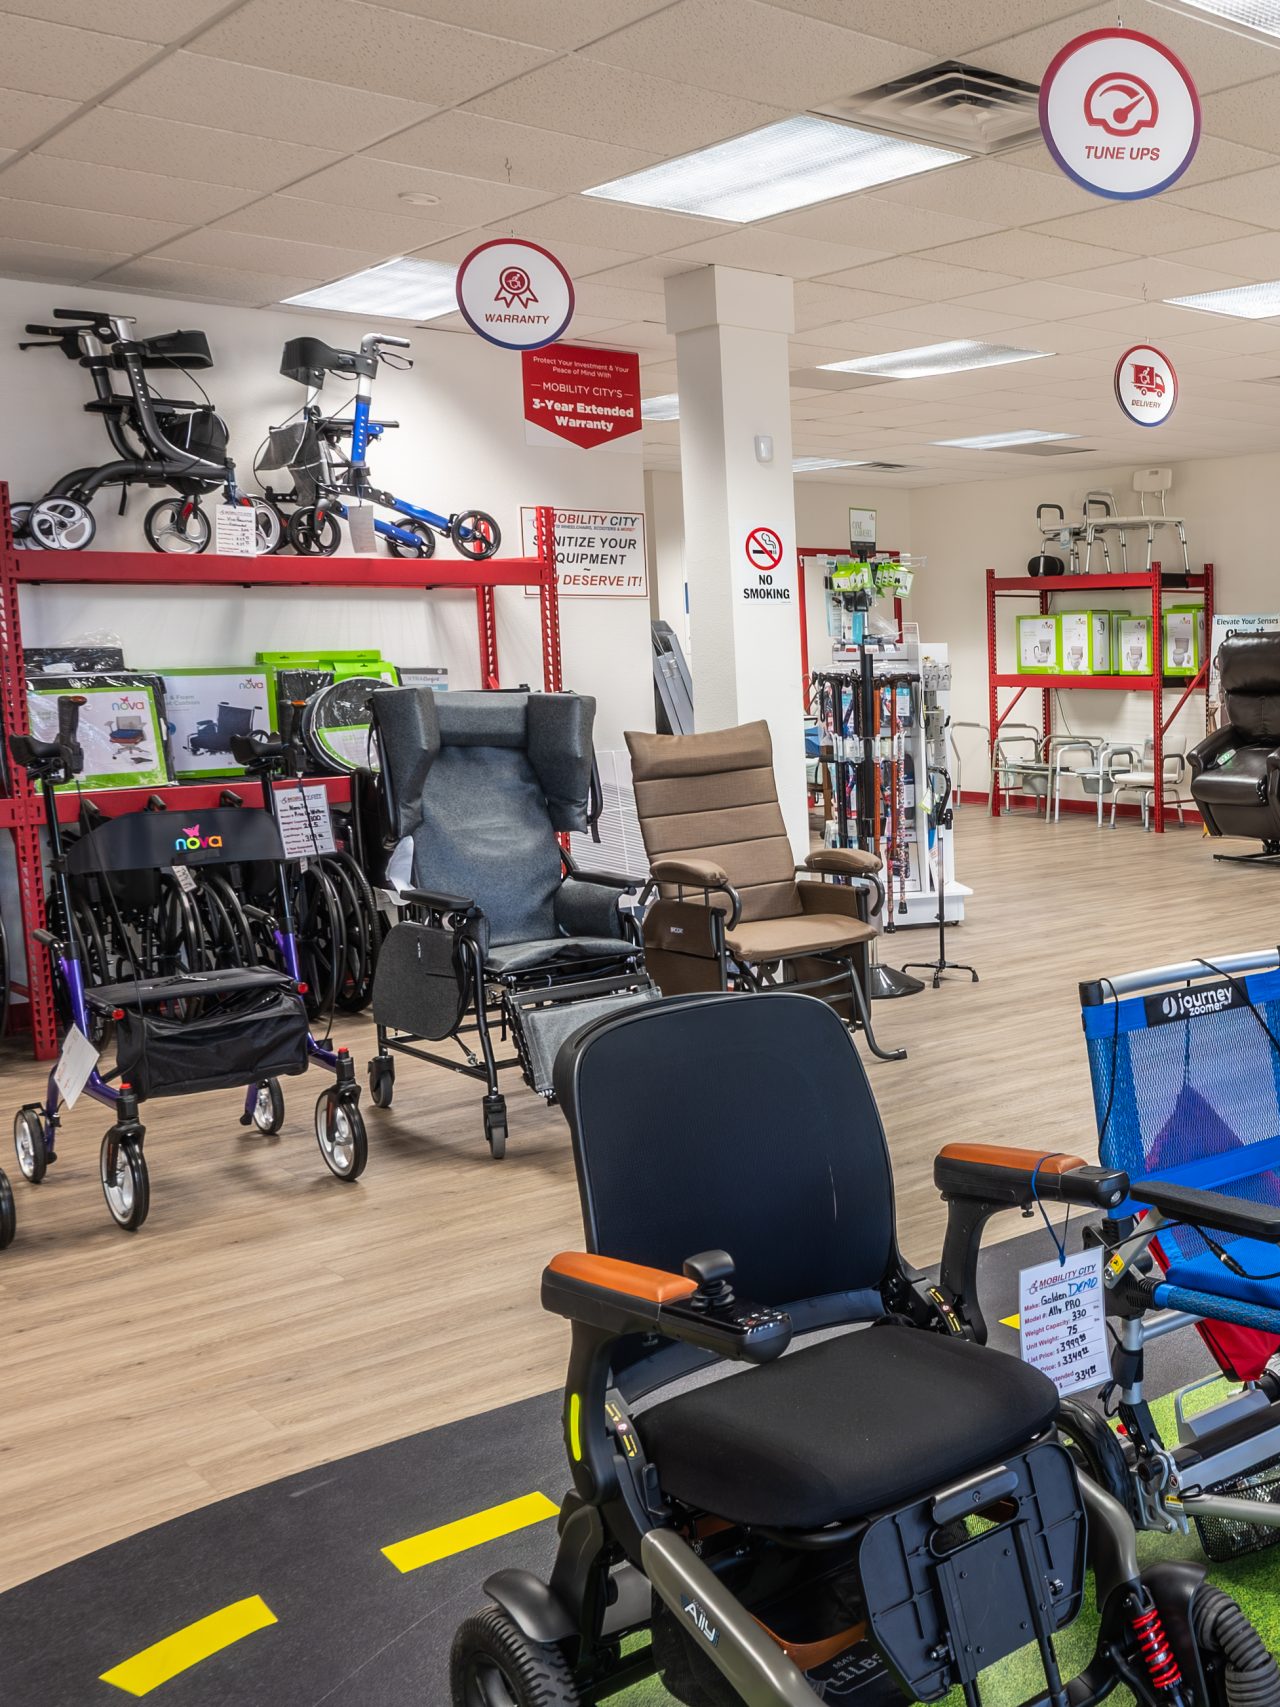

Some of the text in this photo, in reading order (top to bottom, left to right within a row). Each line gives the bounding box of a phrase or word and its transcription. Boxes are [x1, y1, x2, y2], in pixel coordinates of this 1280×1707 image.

[1085, 145, 1161, 161] TUNE UPS
[485, 313, 550, 325] WARRANTY
[533, 355, 556, 365] Protect
[558, 359, 573, 367] Your
[574, 361, 608, 371] Investment
[553, 366, 572, 374] Peace
[543, 381, 623, 398] MOBILITY CITY'S
[532, 398, 634, 418] 3-Year Extended
[1131, 400, 1161, 409] DELIVERY
[555, 416, 614, 432] Warranty
[610, 516, 638, 526] CITY
[532, 534, 637, 550] SNITIZE YOUR
[556, 552, 626, 565] QUIPMENT
[563, 574, 624, 587] DESERVE
[627, 576, 642, 587] IT!
[758, 574, 773, 586] NO
[744, 588, 790, 600] SMOKING
[1216, 618, 1240, 626] Elevate
[239, 681, 264, 690] nova
[112, 700, 144, 711] nova
[176, 836, 222, 850] nova
[1178, 986, 1232, 1015] journey
[1188, 1000, 1223, 1016] zoomer
[1039, 1264, 1096, 1288] MOBILITY CITY
[1024, 1292, 1067, 1312] Make: Golden
[1024, 1314, 1042, 1324] Model
[1048, 1305, 1062, 1317] Ally
[1064, 1298, 1080, 1311] PRO
[1024, 1308, 1087, 1338] Weight Capacity: 330
[1026, 1324, 1078, 1351] Unit Weight: 75
[1027, 1353, 1038, 1363] List
[1038, 1351, 1055, 1361] Price:
[684, 1602, 716, 1643] Ally
